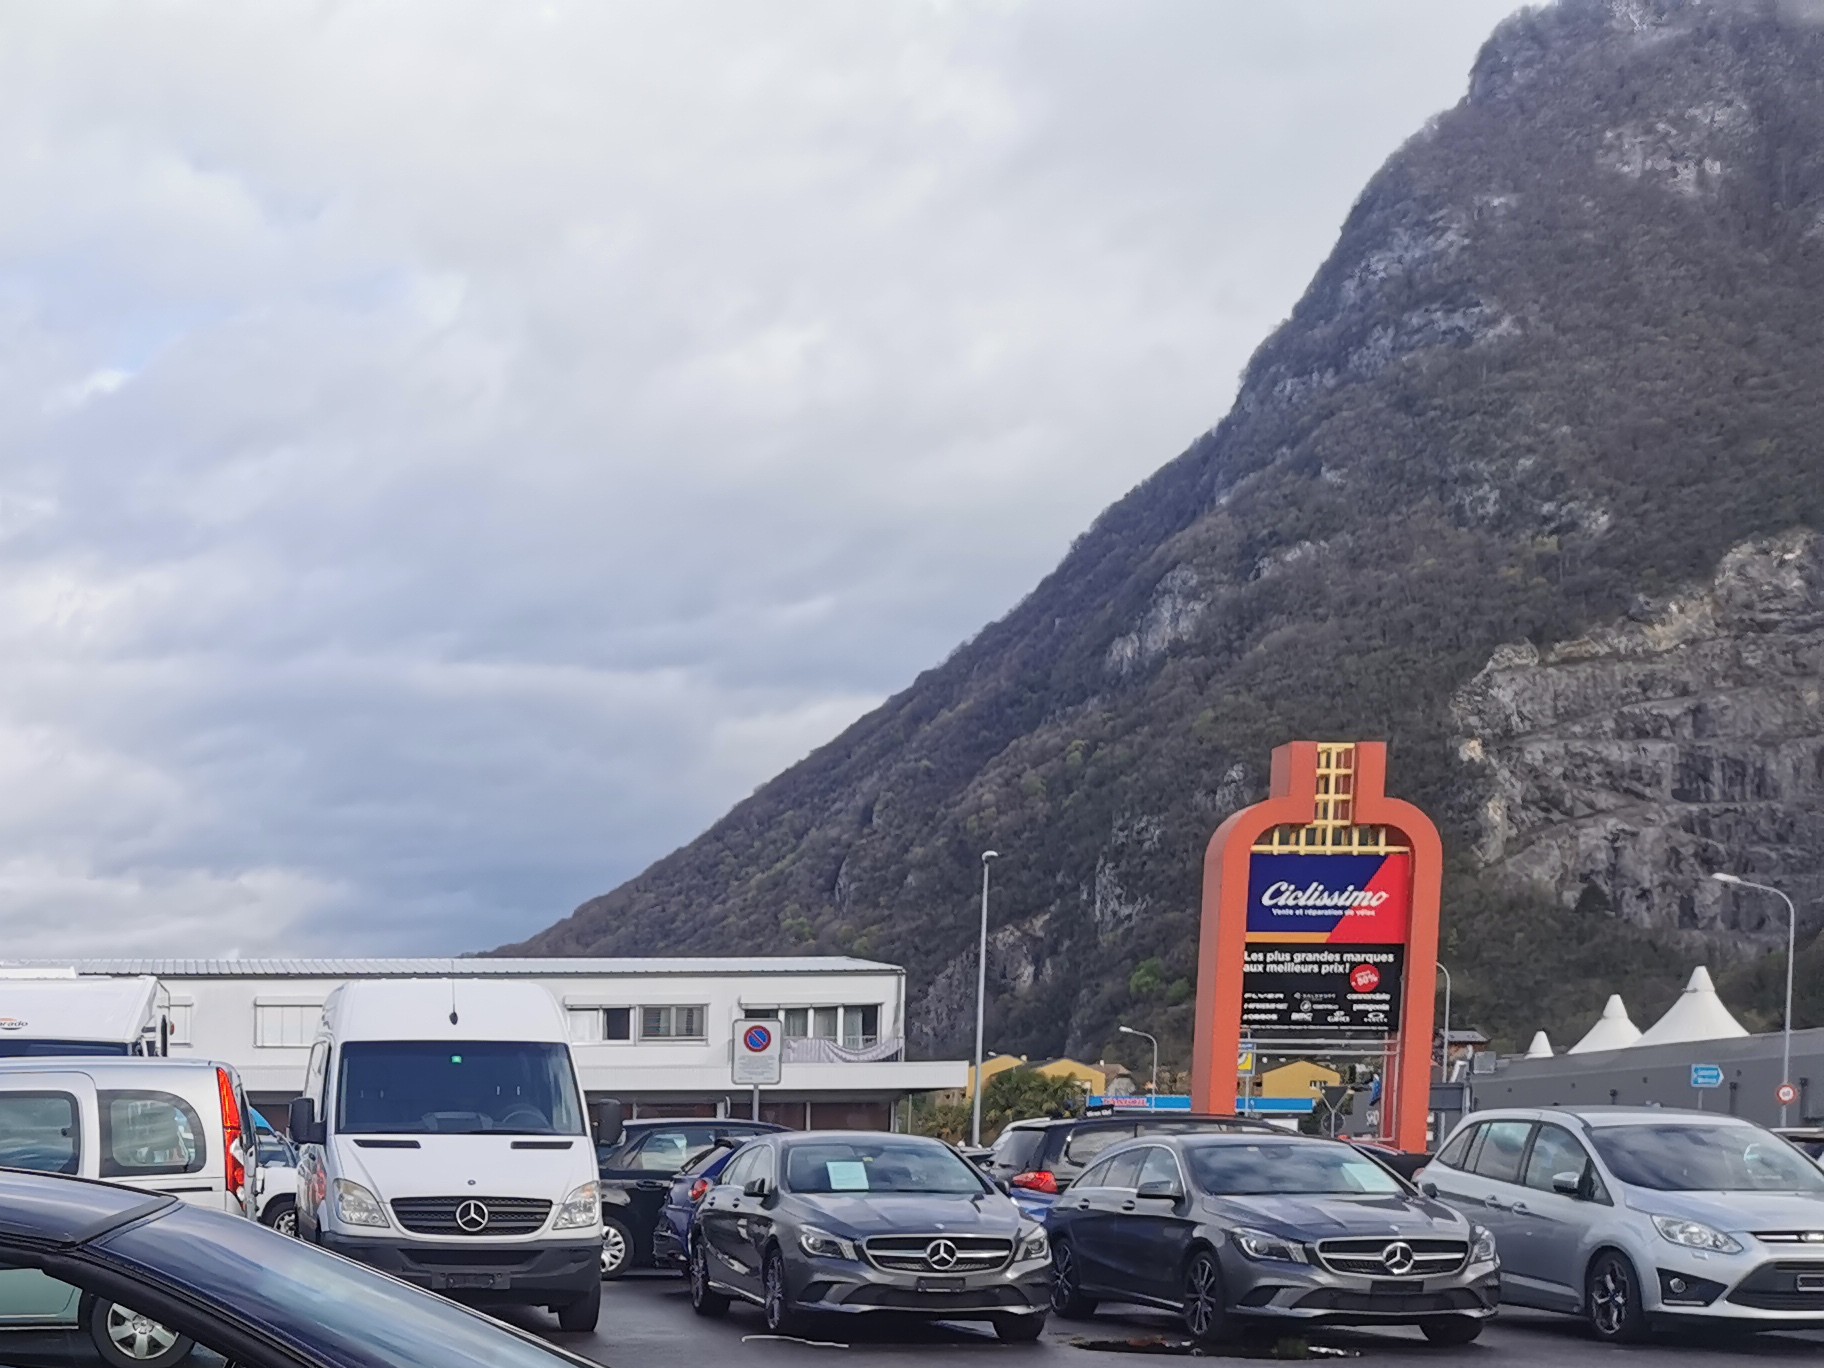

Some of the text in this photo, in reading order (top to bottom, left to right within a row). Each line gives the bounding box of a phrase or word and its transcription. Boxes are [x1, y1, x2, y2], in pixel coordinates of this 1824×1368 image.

[1261, 880, 1390, 907] Ciclissimo
[1271, 907, 1294, 916] Vente
[1295, 908, 1304, 916] et
[1243, 950, 1394, 963] Les plus grandes marques
[1243, 963, 1264, 973] aux
[1266, 962, 1319, 974] meilleurs
